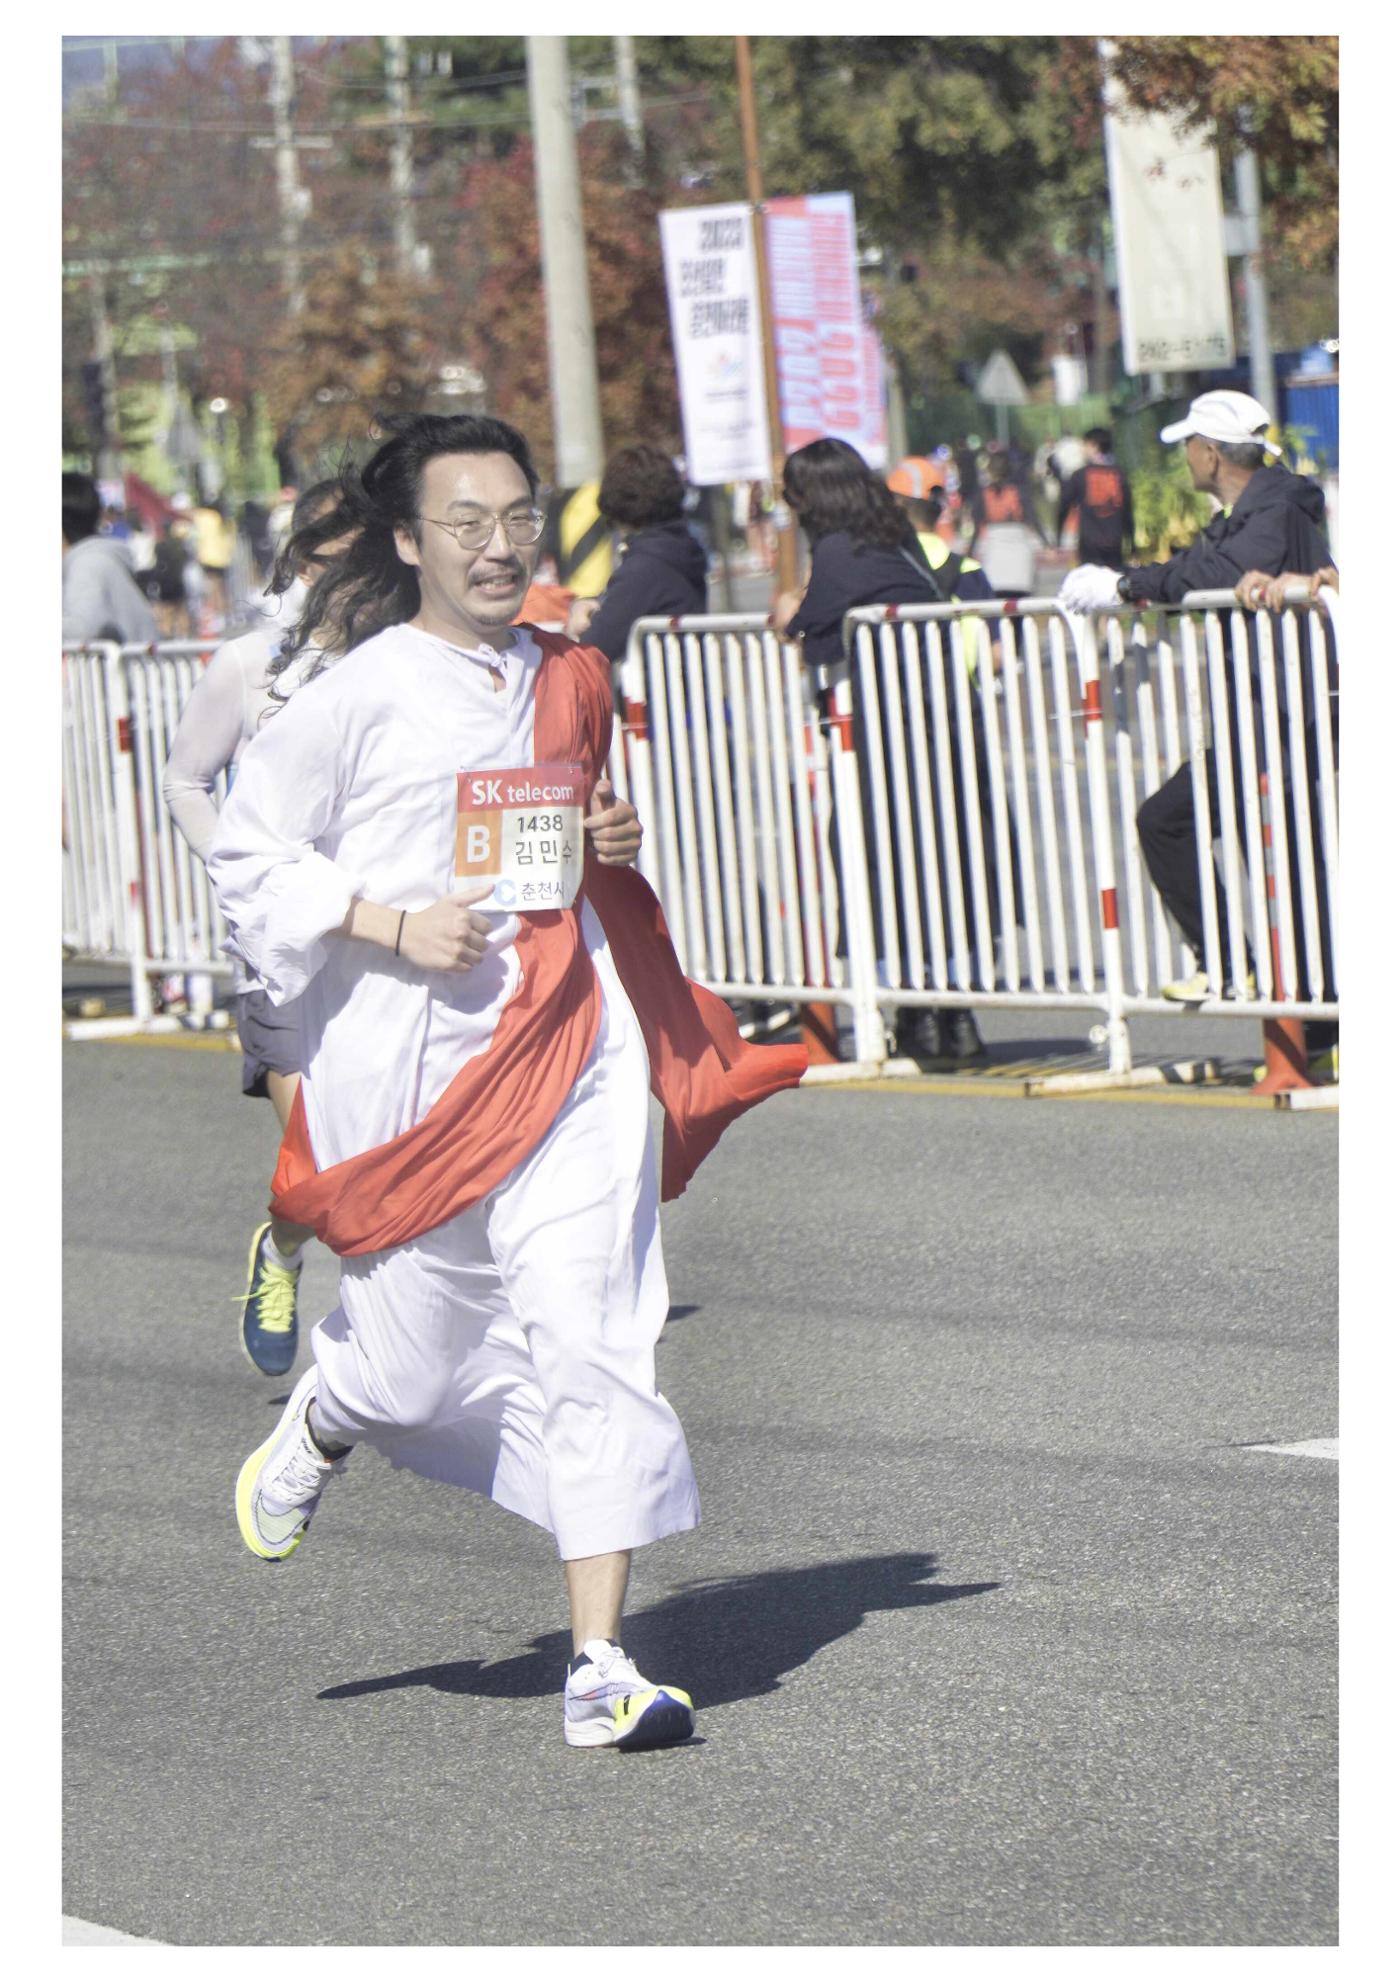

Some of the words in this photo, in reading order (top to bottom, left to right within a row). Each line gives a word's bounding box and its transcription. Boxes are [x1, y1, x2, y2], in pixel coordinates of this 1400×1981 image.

[471, 779, 503, 806] SK
[507, 781, 574, 803] telecom
[517, 814, 564, 834] 1438
[466, 825, 491, 864] B
[515, 839, 573, 866] 김민수
[521, 880, 565, 901] 춘천시
